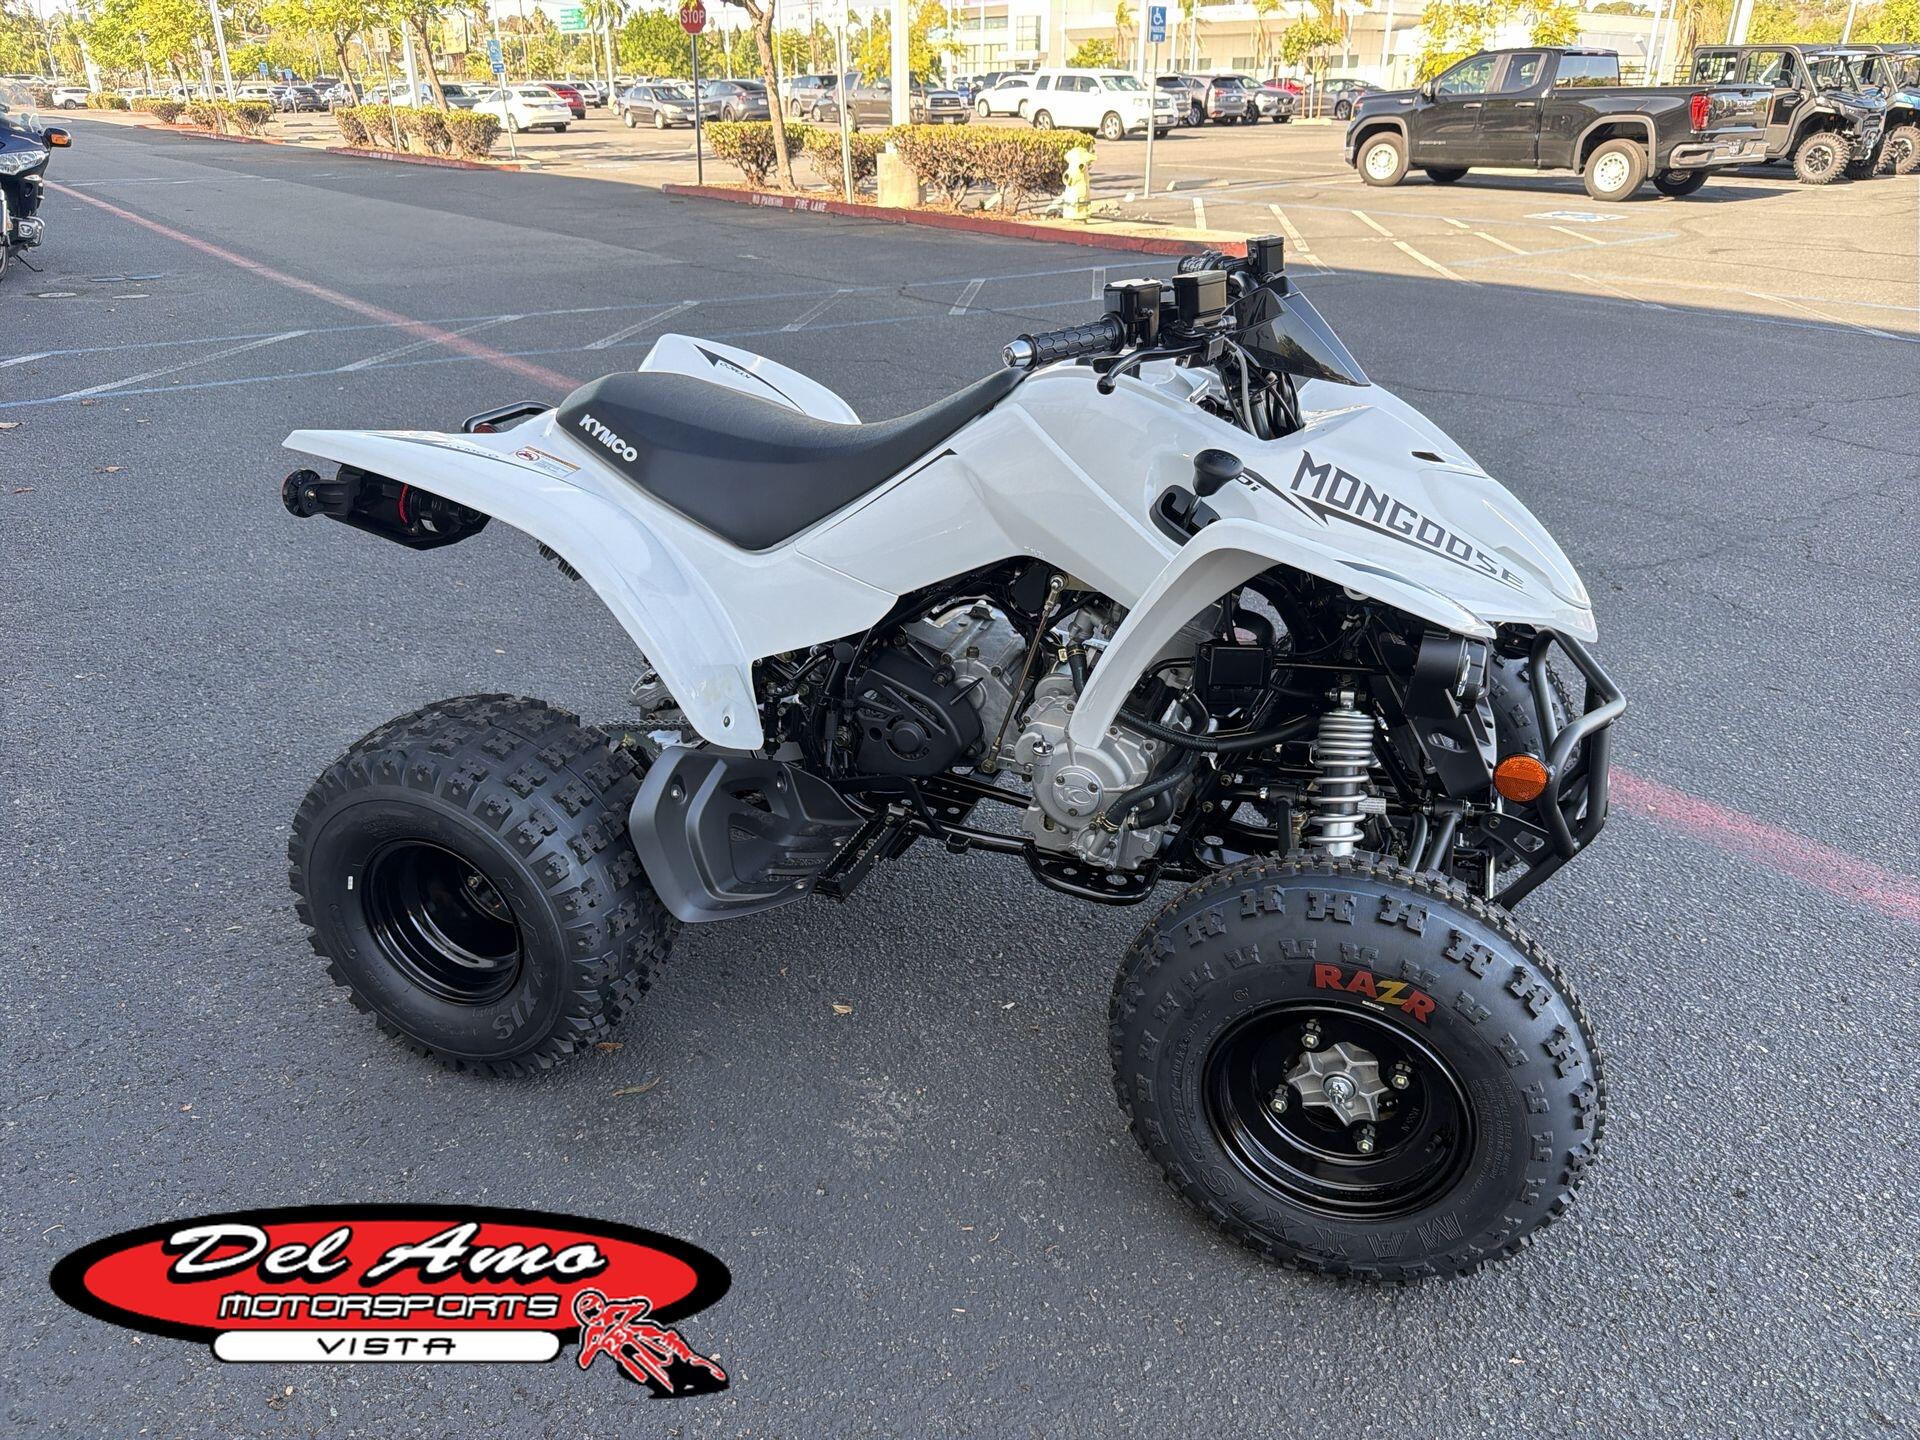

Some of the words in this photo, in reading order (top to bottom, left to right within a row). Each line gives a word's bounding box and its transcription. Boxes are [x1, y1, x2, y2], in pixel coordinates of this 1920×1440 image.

[681, 9, 705, 24] STOP
[794, 198, 810, 210] FIRE
[810, 200, 828, 213] LANE
[579, 414, 638, 461] KYMCO
[1290, 449, 1525, 590] MONGOOSE
[1314, 962, 1437, 1025] RAZR
